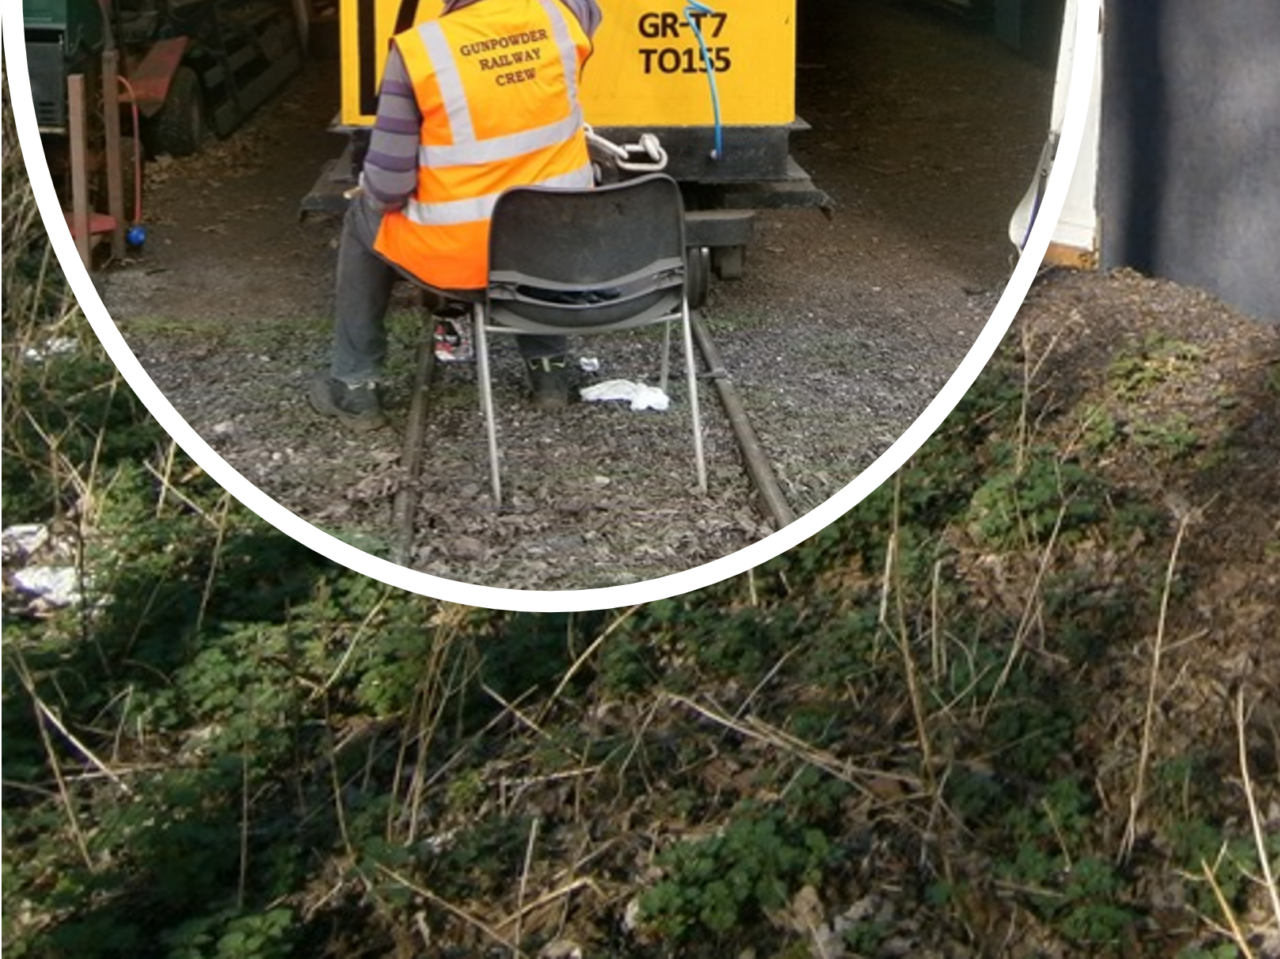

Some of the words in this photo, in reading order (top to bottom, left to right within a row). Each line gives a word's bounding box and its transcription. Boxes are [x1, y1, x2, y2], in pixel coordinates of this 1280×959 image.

[460, 29, 548, 56] GUNPOWDER
[479, 47, 541, 71] RAILWAY
[495, 67, 536, 87] CREW
